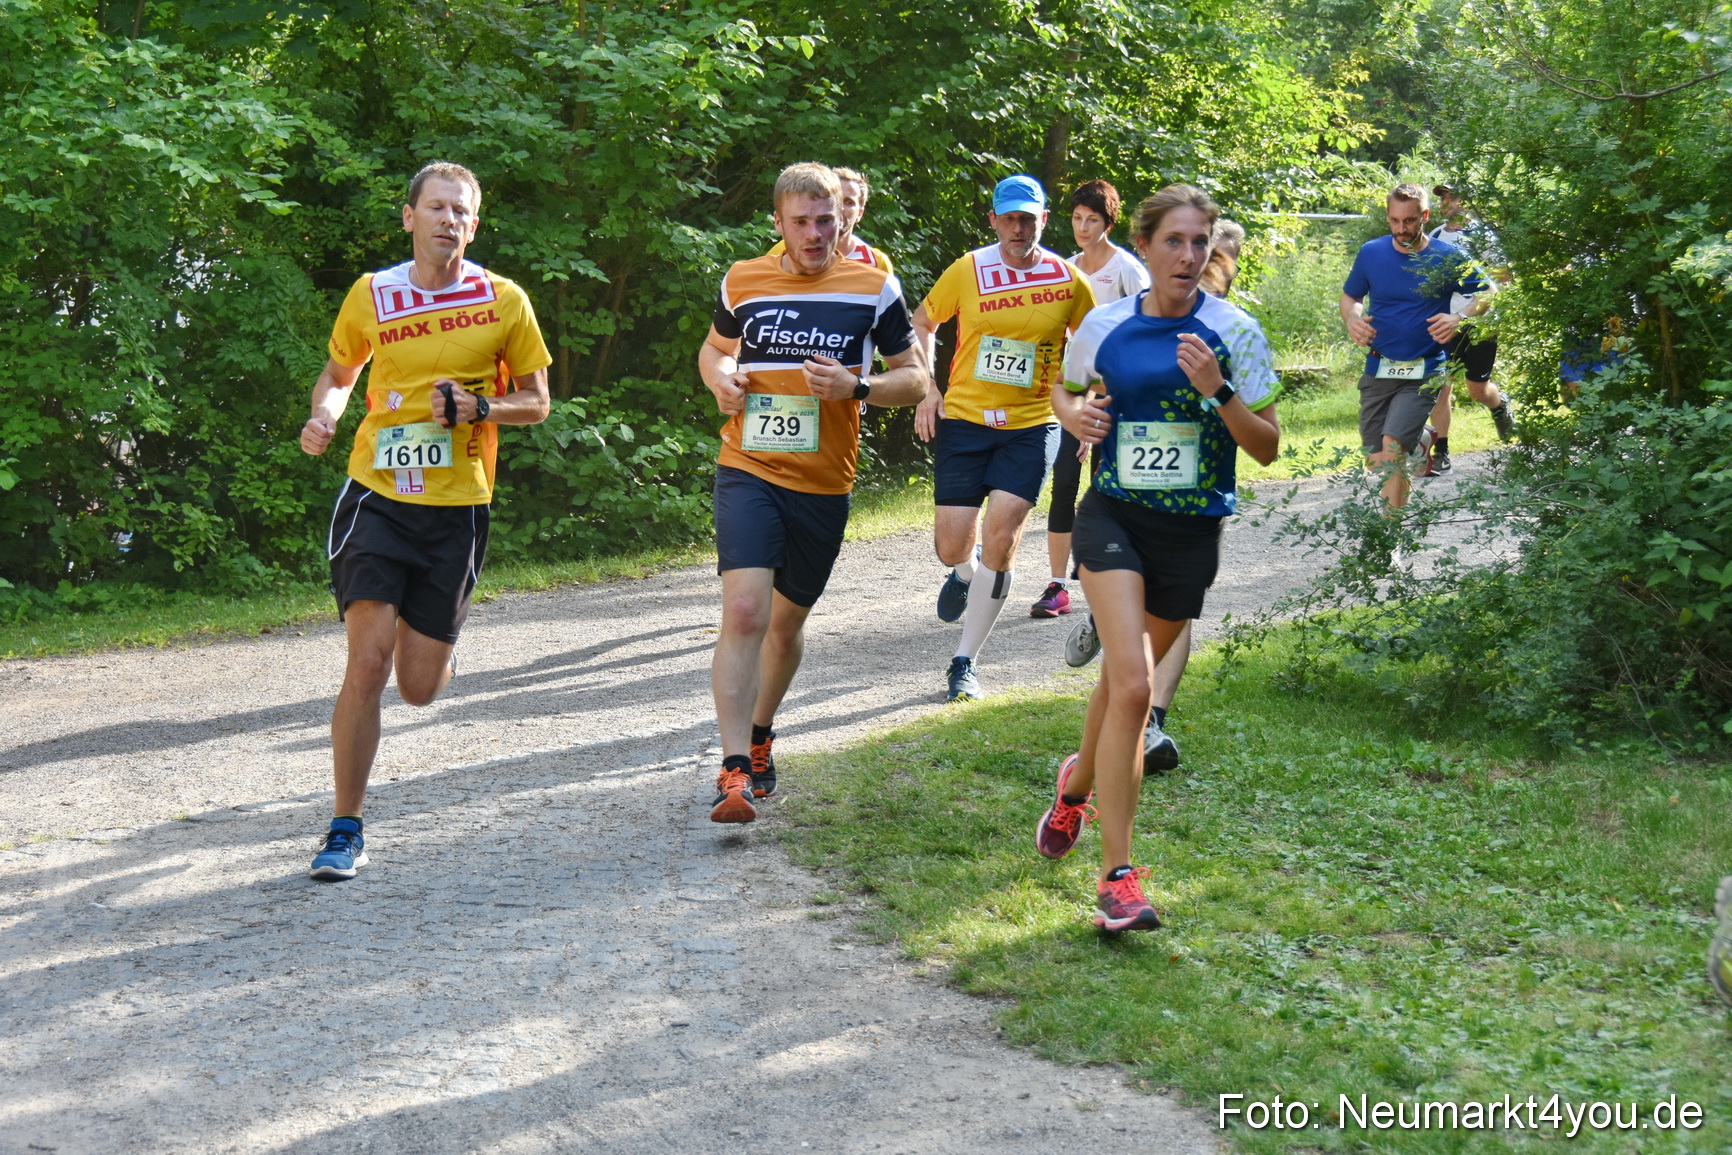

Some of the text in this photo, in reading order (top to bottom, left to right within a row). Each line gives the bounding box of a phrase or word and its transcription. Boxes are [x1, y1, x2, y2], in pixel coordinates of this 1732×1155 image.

[979, 288, 1074, 313] MAX BÖGL
[379, 309, 501, 346] MAX BÖGL
[757, 325, 855, 349] Fischer
[766, 346, 845, 360] AUTOMOBILE
[984, 352, 1027, 374] 1574
[1387, 367, 1415, 376] 867
[759, 415, 800, 436] 739
[384, 444, 442, 467] 1610
[1132, 447, 1180, 470] 222
